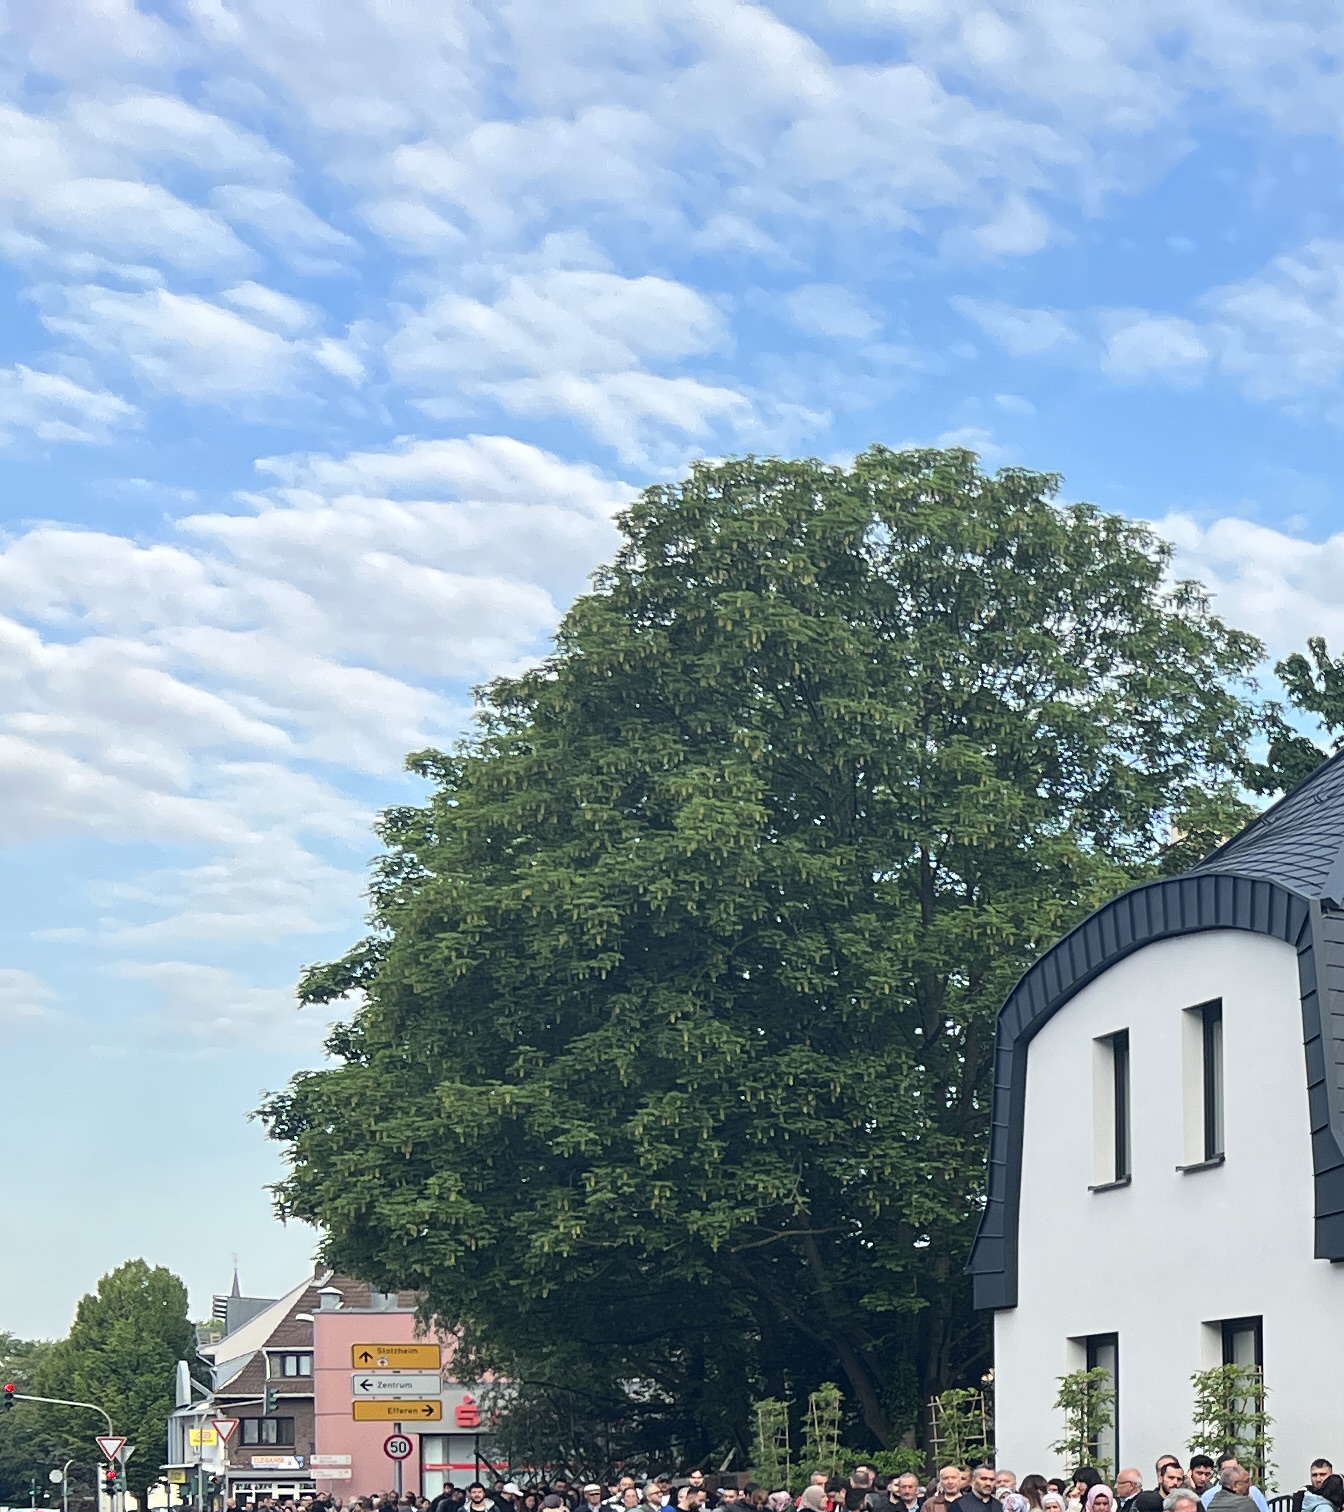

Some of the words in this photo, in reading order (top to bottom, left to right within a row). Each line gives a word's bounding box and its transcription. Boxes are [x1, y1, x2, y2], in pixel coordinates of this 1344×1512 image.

[377, 1381, 412, 1389] Zentrum
[387, 1407, 418, 1415] Efferen
[390, 1441, 407, 1453] 50
